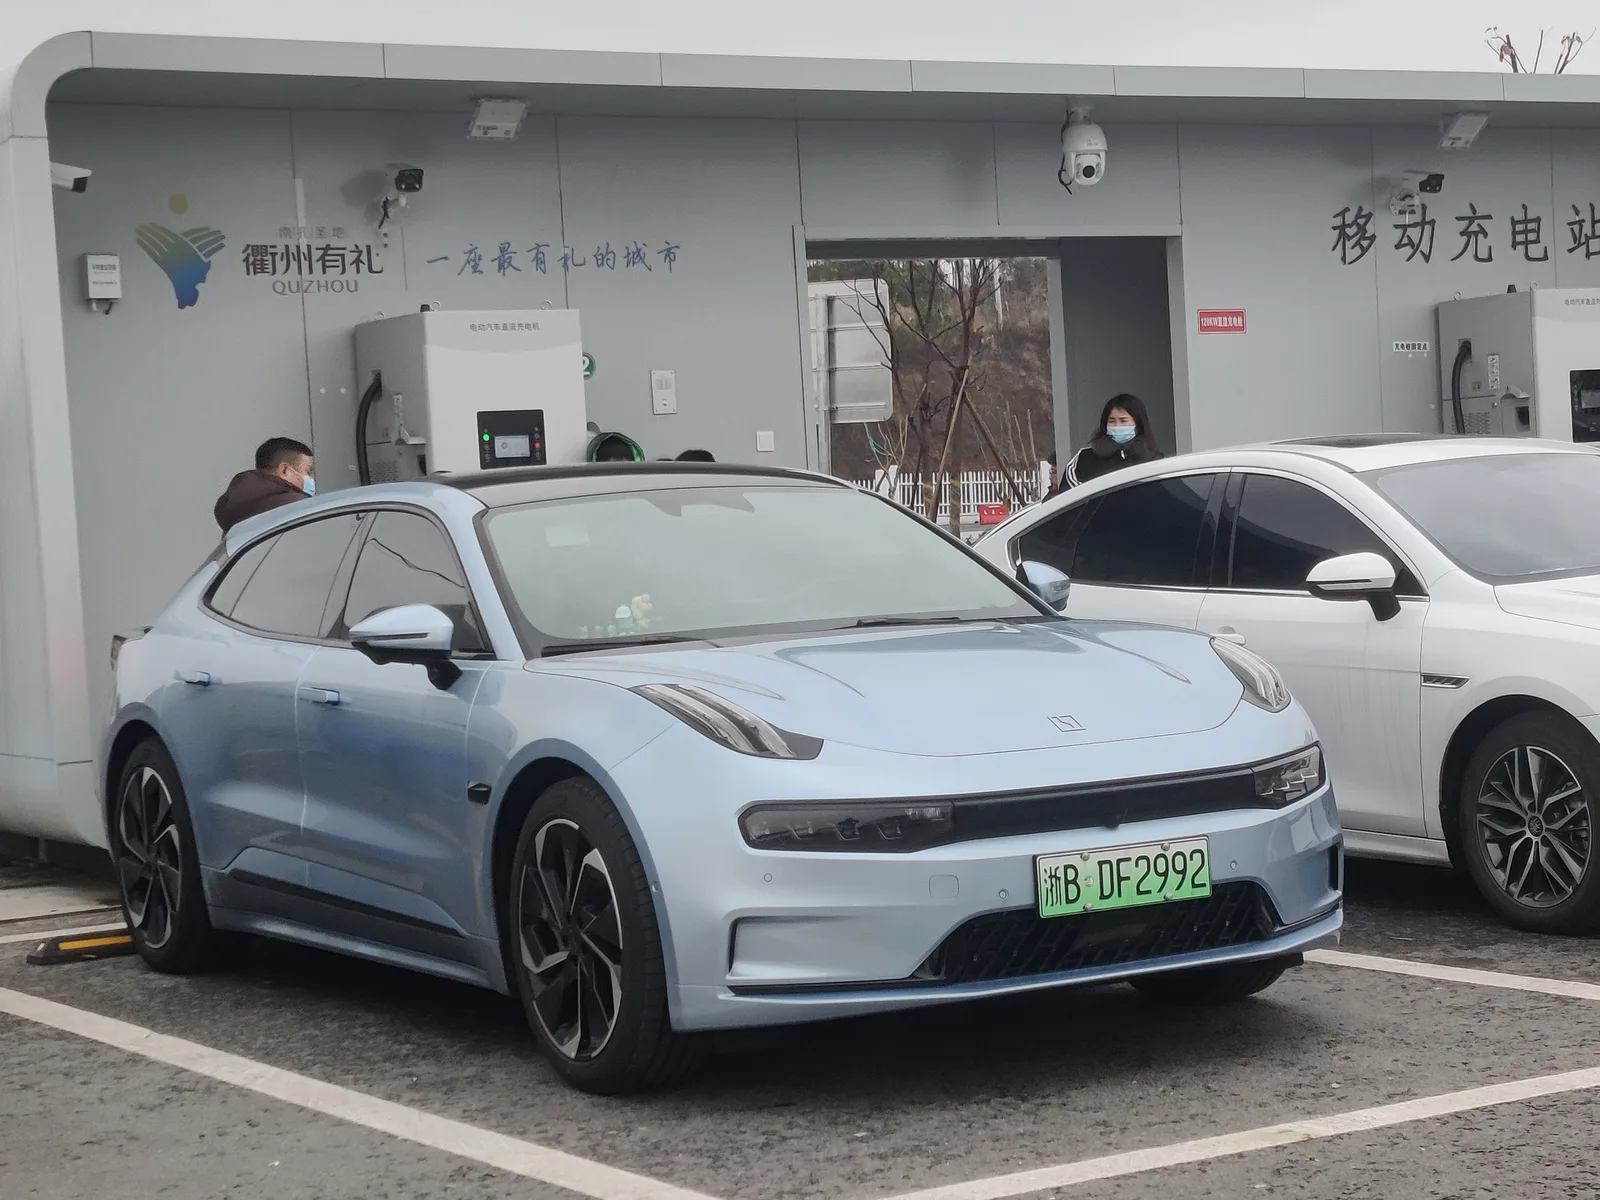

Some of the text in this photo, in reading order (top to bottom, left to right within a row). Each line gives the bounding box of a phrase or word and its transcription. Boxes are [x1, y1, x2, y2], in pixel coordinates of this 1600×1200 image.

[1331, 202, 1600, 265] 移动充电站
[241, 243, 384, 276] 衢州有礼
[426, 240, 680, 277] 一座最有礼的城市
[272, 279, 359, 296] QUZHOU
[1097, 848, 1207, 900] DF2992
